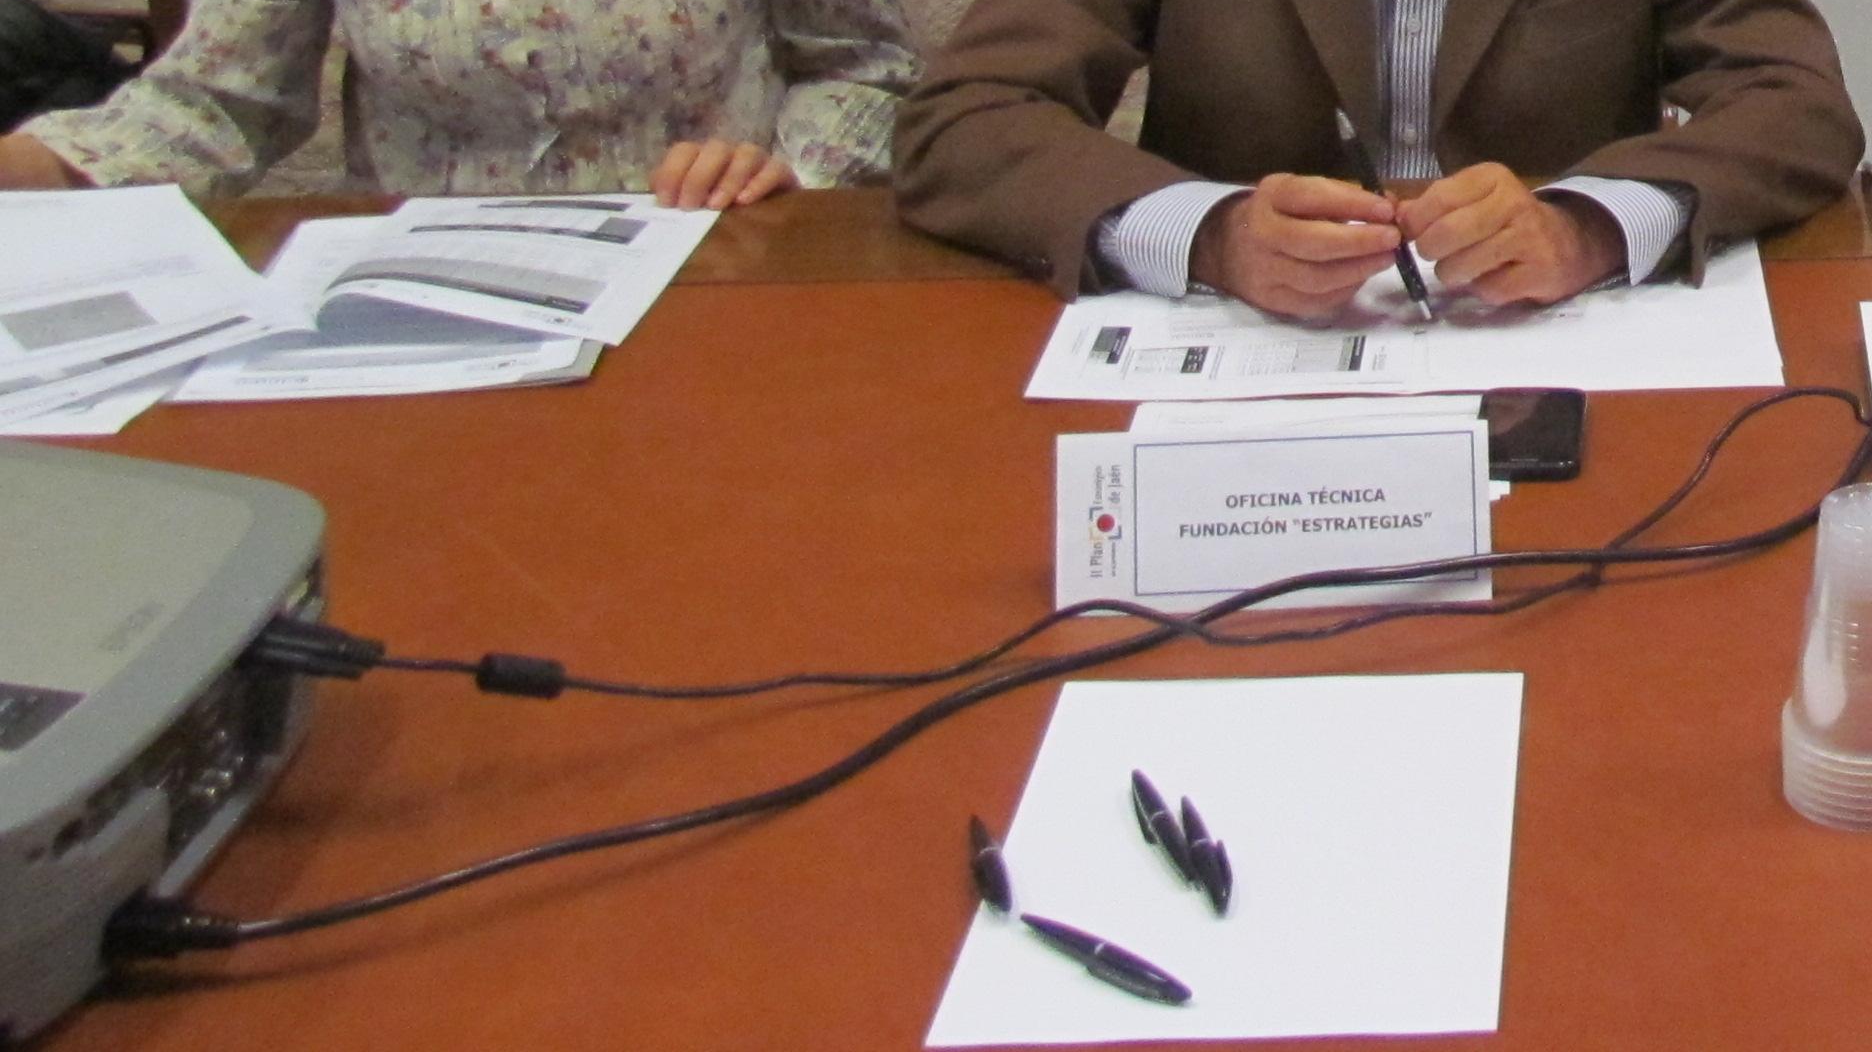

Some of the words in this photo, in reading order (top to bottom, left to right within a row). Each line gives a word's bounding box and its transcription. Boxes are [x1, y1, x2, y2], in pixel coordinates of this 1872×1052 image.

[1225, 492, 1302, 509] OFICINA
[1307, 487, 1386, 505] TÉCNICA
[1179, 517, 1287, 538] FUNDACIÓN
[1090, 542, 1104, 567] Plan
